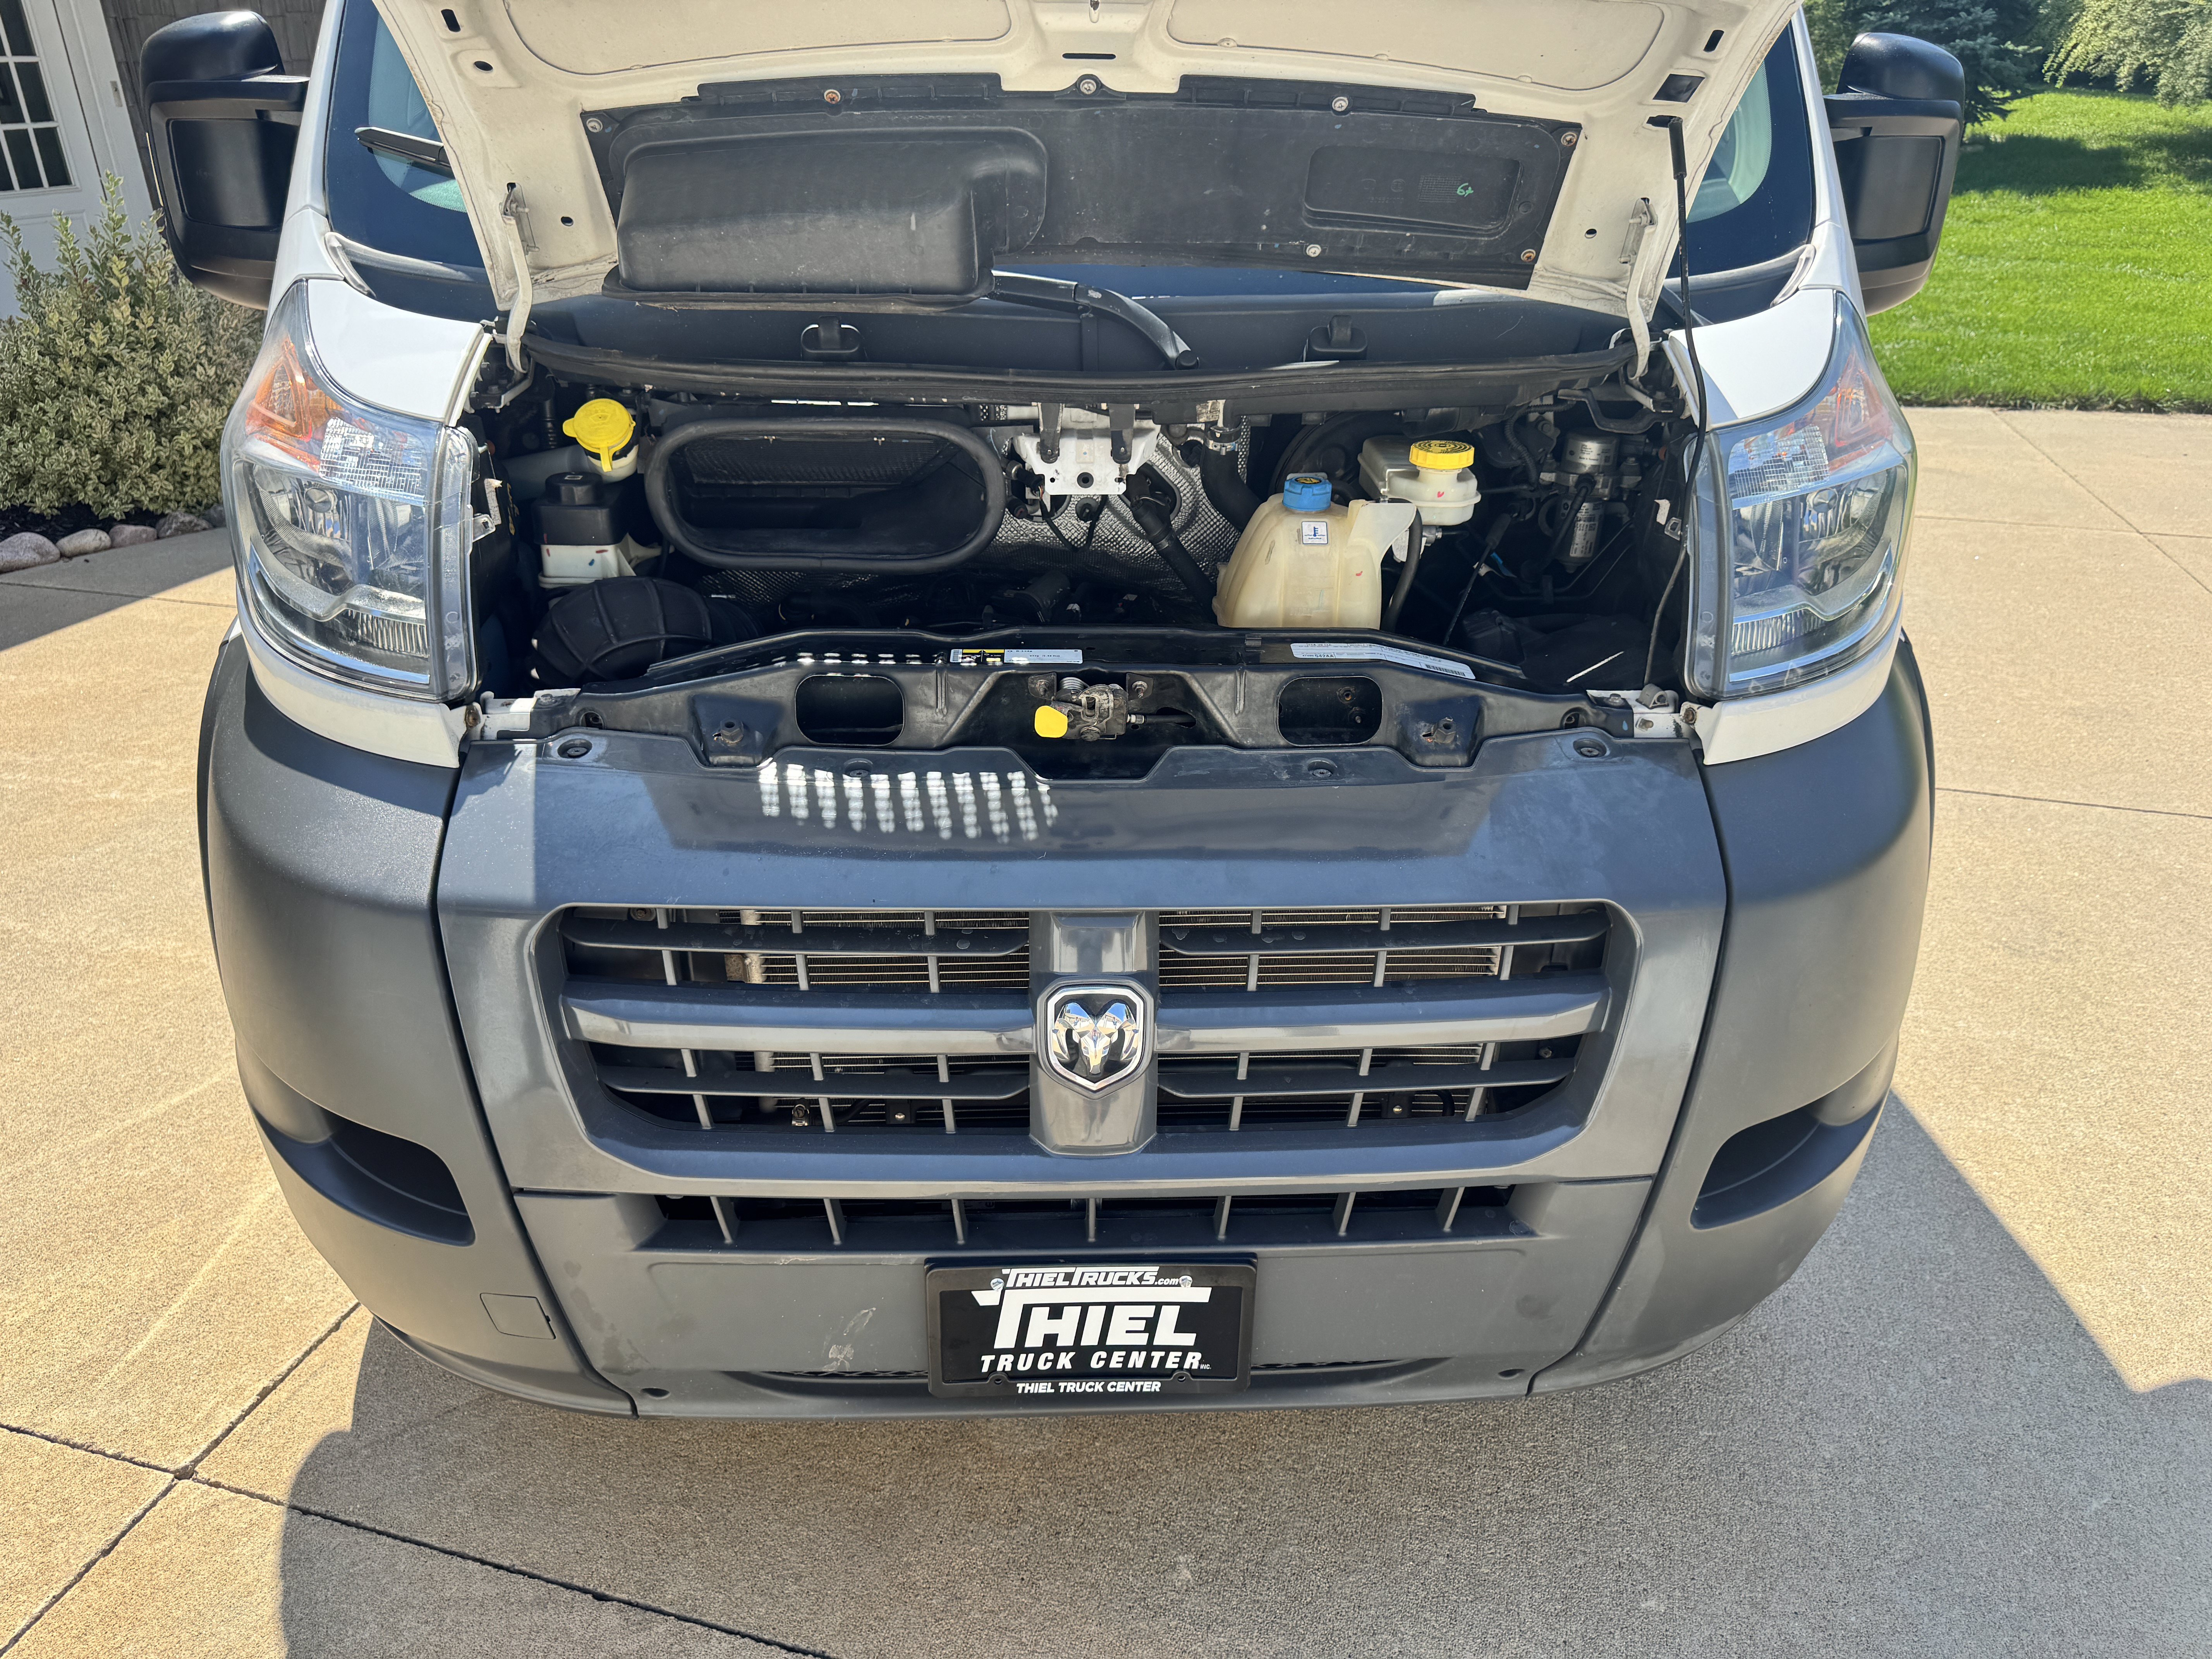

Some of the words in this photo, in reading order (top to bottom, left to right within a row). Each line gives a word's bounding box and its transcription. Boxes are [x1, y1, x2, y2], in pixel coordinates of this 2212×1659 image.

[1001, 1266, 1179, 1288] THIELTRUCKS.com
[971, 1286, 1212, 1349] THIEL
[981, 1352, 1076, 1372] TRUCK
[1090, 1351, 1202, 1369] CENTER
[1016, 1382, 1055, 1394] THIEL
[1058, 1381, 1105, 1393] TRUCK
[1107, 1381, 1161, 1392] CENTER
